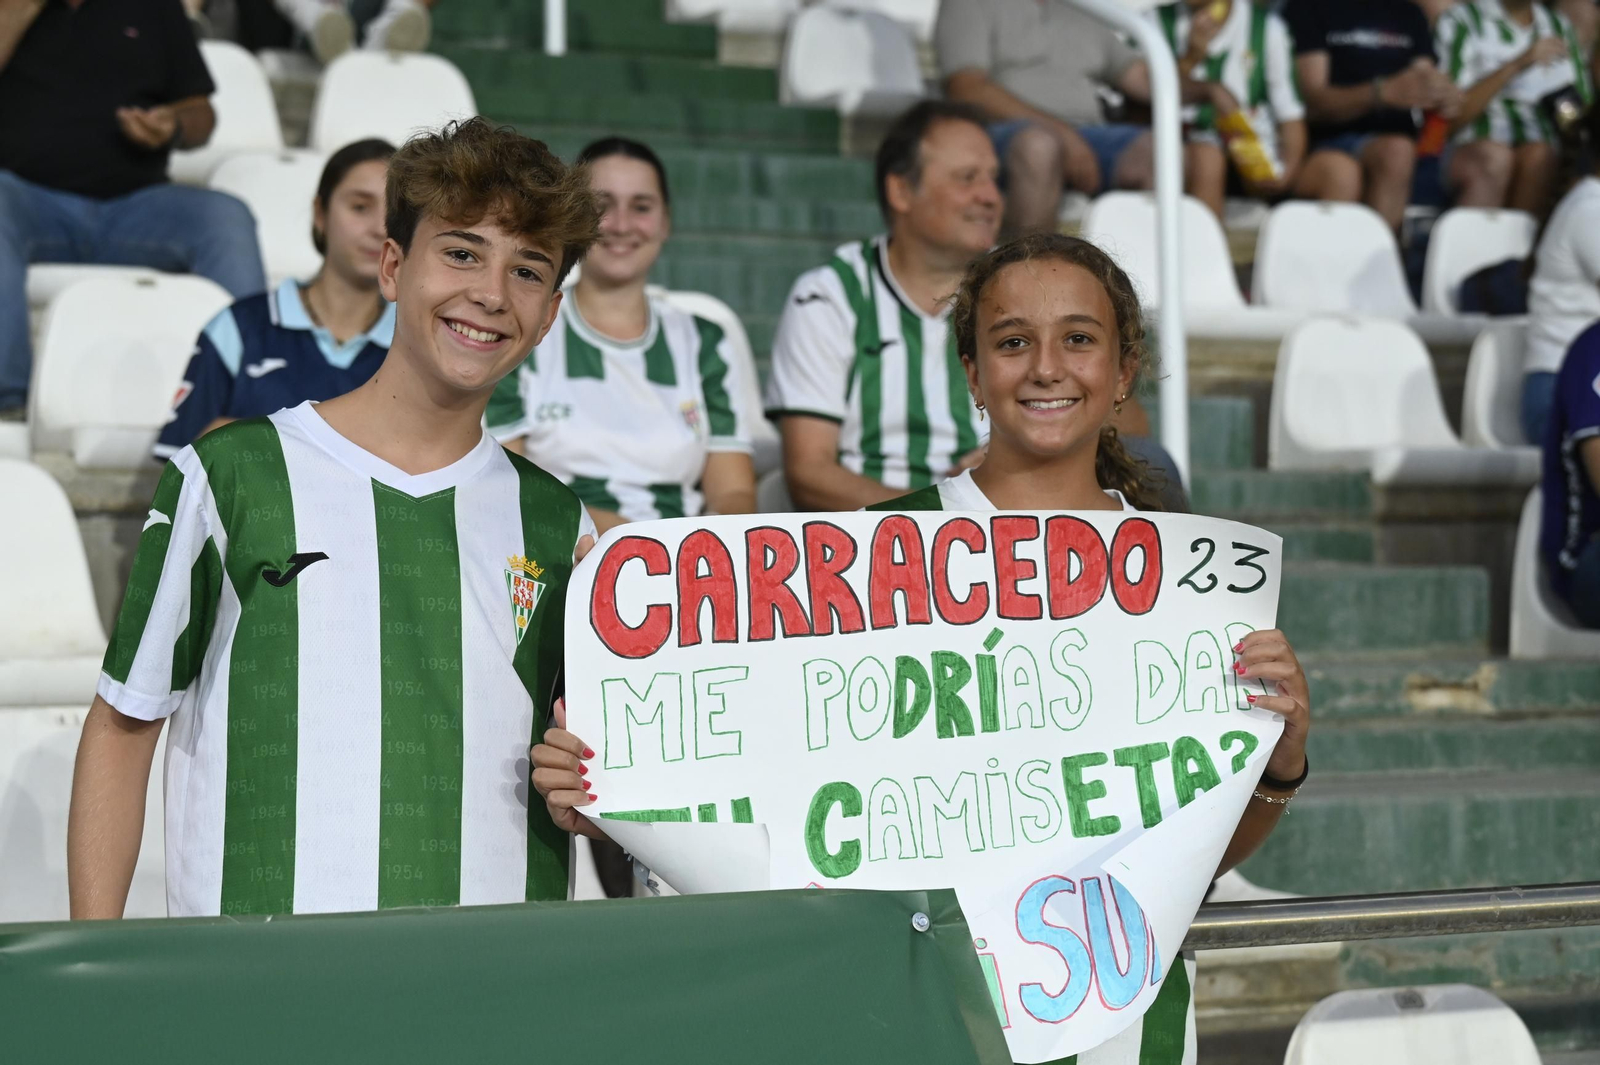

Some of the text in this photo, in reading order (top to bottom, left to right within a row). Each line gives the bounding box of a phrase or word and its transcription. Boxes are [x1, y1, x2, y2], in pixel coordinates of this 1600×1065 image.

[233, 451, 274, 465] 1954
[245, 504, 283, 524] 1954
[380, 505, 419, 523] 1954
[417, 537, 455, 553] 1954
[383, 562, 423, 578] 1954
[589, 515, 1270, 660] CARRACEDO 23
[419, 596, 458, 612] 1954
[251, 622, 289, 639] 1954
[384, 621, 425, 637] 1954
[420, 657, 461, 671] 1954
[252, 682, 288, 700] 1954
[386, 680, 426, 696] 1954
[601, 666, 749, 770] ME
[802, 627, 1092, 752] PODRÍAS
[422, 713, 460, 730] 1954
[252, 742, 289, 759] 1954
[386, 741, 427, 756] 1954
[421, 774, 459, 792] 1954
[250, 804, 287, 820] 1954
[384, 802, 427, 817] 1954
[419, 838, 460, 853] 1954
[250, 866, 284, 882] 1954
[384, 862, 424, 880] 1954
